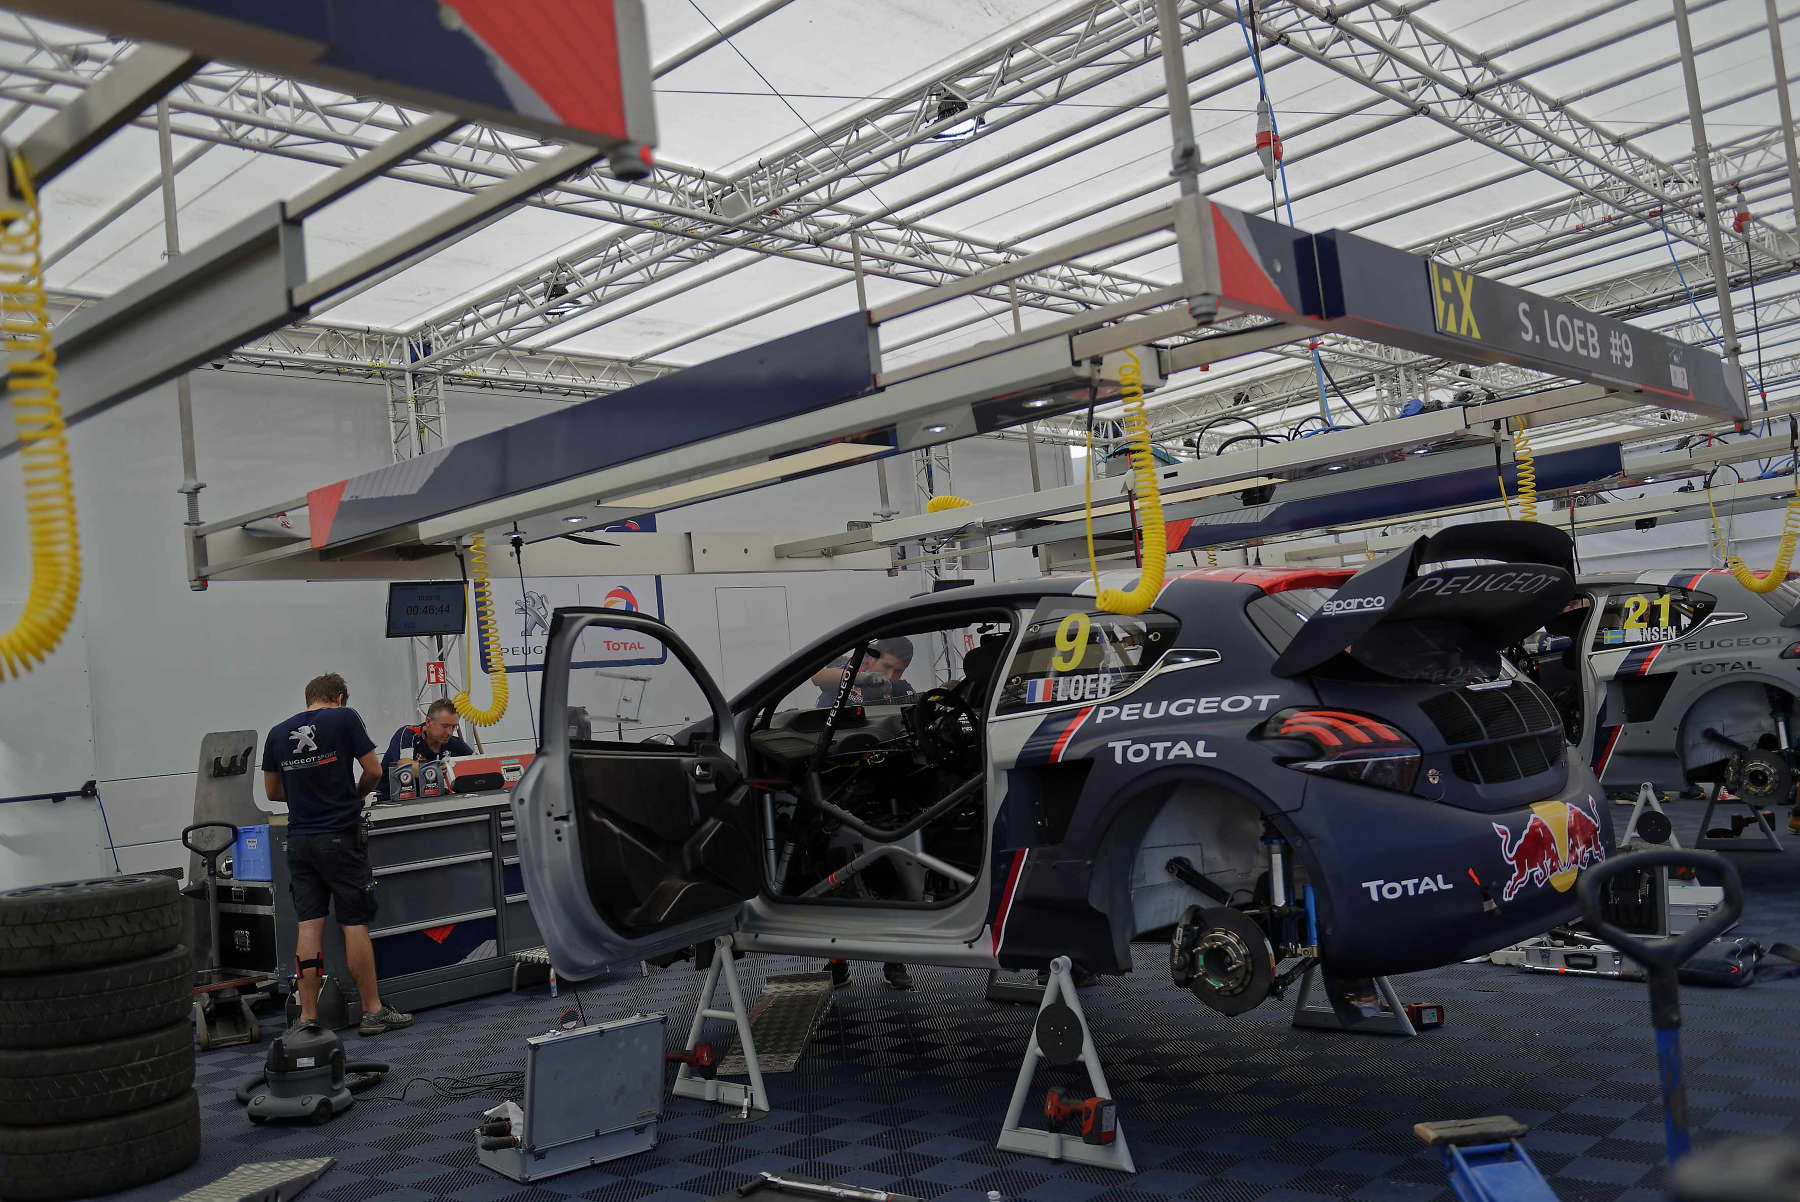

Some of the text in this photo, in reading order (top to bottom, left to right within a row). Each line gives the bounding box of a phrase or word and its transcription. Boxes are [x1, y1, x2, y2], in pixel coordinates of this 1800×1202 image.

[1517, 302, 1634, 368] S. LOEB #9
[1408, 572, 1560, 600] PEUGEOT
[406, 603, 450, 616] 00:46:44
[1322, 594, 1386, 617] sparco
[1623, 594, 1671, 630] 21
[603, 640, 645, 651] TOTAL
[1052, 613, 1091, 672] 9
[1625, 626, 1677, 643] NSEN
[1665, 635, 1784, 653] PEUGEOT
[500, 645, 544, 656] PEUG
[1688, 661, 1761, 675] TOTAL
[826, 663, 856, 727] PEUGEOT
[1056, 674, 1112, 701] LOEB
[1096, 693, 1280, 724] PEUGEOT
[280, 756, 317, 767] PEUGEOT
[1107, 739, 1217, 765] TOTAL
[1362, 874, 1453, 901] TOTAL
